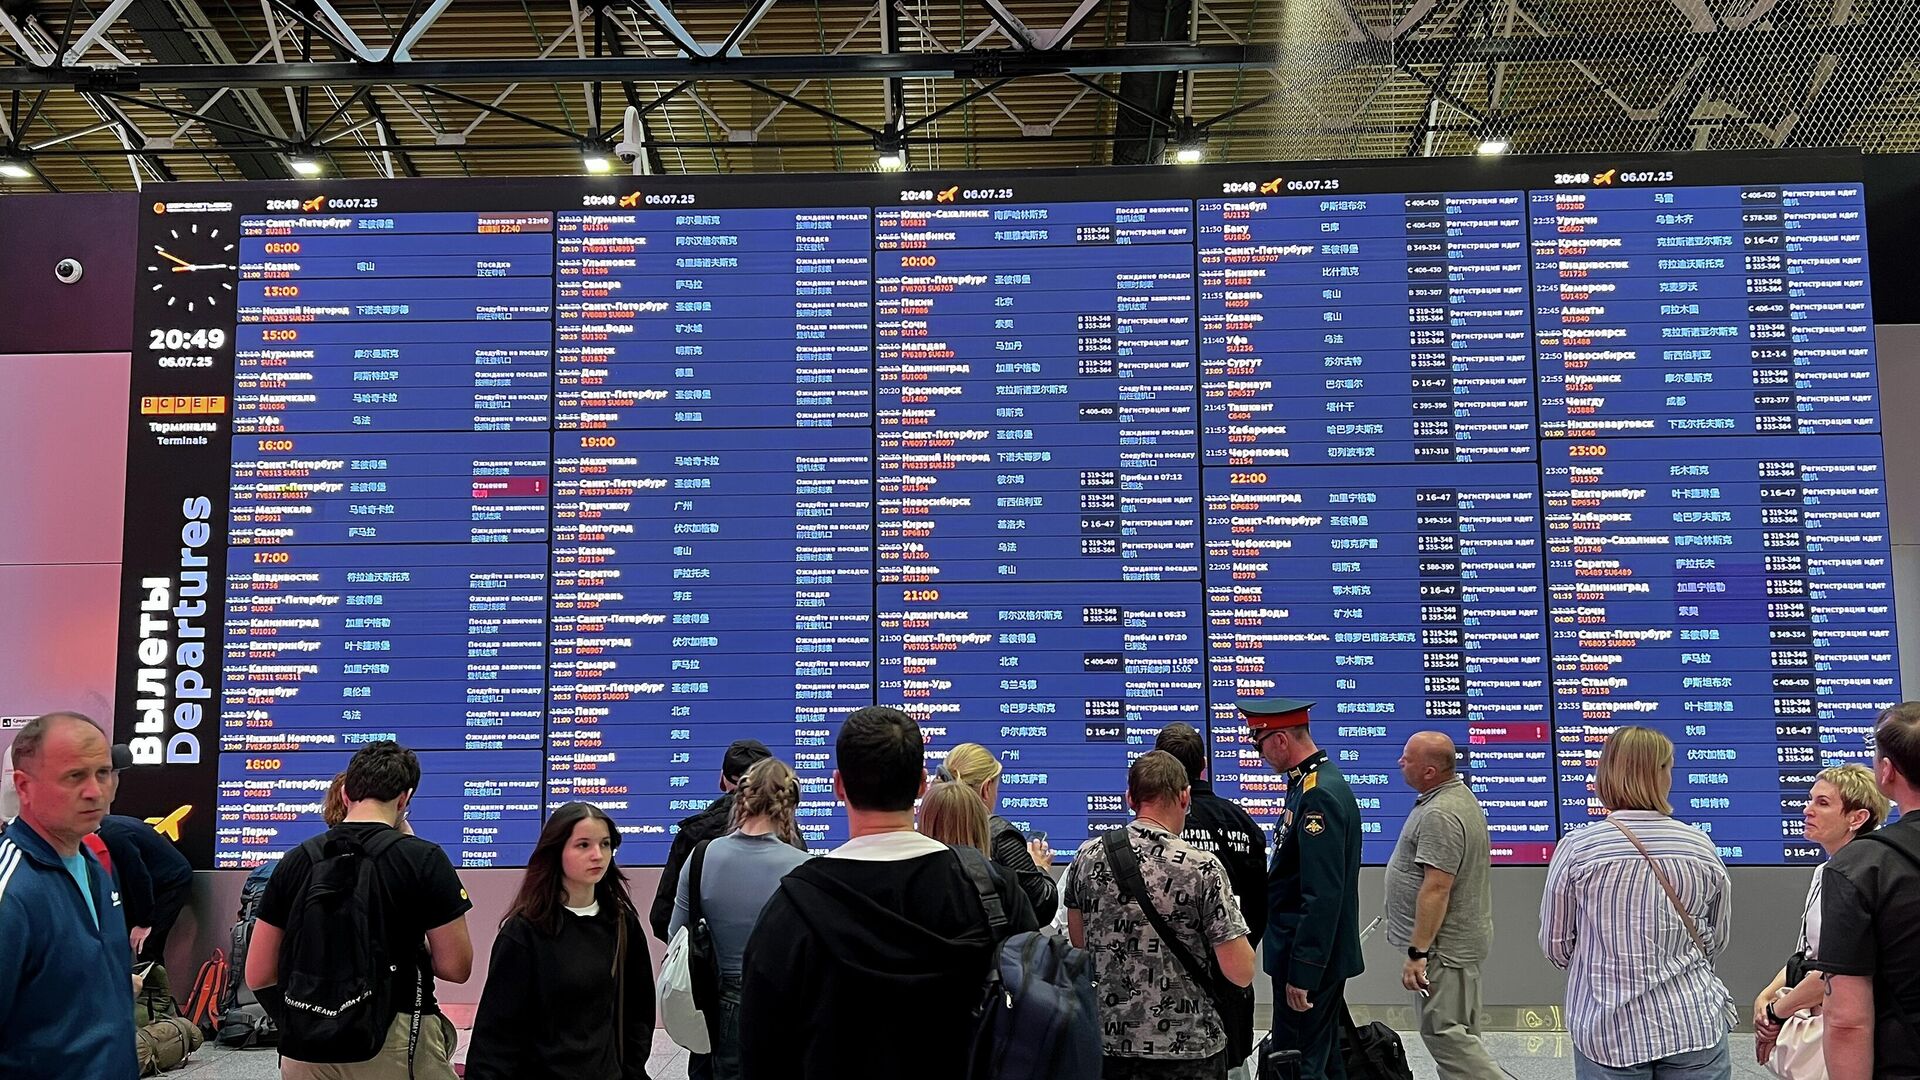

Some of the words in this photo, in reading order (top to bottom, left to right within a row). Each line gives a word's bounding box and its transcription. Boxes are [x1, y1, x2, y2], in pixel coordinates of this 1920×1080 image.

[1555, 173, 1589, 184] 20:49
[1620, 171, 1673, 182] 06.07.25
[1223, 182, 1256, 193] 20:49
[1287, 180, 1339, 191] 06.07.25
[583, 195, 615, 205] 20:49
[645, 194, 695, 204] 06.07.25
[901, 190, 933, 201] 20:49
[963, 189, 1013, 200] 06.07.25
[1532, 194, 1554, 202] 22:35
[1556, 193, 1586, 203] Мале
[266, 198, 299, 210] 20:49
[328, 198, 378, 209] 06.07.25
[1223, 201, 1267, 212] Стамбул
[900, 208, 990, 220] Южно-Сахалинск
[266, 217, 351, 229] Санкт-Петербург
[583, 215, 635, 225] Мурманск
[1557, 215, 1598, 226] Урумчи
[1200, 225, 1222, 233] 21:30
[1224, 224, 1249, 235] Баку
[583, 236, 646, 246] Архангельск
[900, 231, 956, 241] Челябинск
[265, 241, 300, 254] 08:00
[1558, 237, 1621, 248] Красноярск
[1224, 245, 1314, 257] Санкт-Петербург
[264, 261, 300, 272] Казань
[582, 258, 636, 268] Ульяновск
[901, 256, 936, 267] 20:00
[1535, 262, 1558, 270] 22:40
[1559, 259, 1629, 270] Владивосток
[263, 285, 298, 297] 13:00
[1560, 282, 1616, 293] Кемерово
[1201, 292, 1224, 300] 21:35
[262, 305, 301, 316] Нижний
[303, 306, 349, 317] Новгород
[1537, 307, 1560, 315] 22:45
[1561, 305, 1604, 315] Алматы
[902, 320, 927, 329] Сочи
[149, 328, 225, 349] 20:49
[262, 329, 297, 341] 15:00
[902, 341, 946, 352] Магадан
[261, 348, 314, 360] Мурманск
[1564, 349, 1636, 361] Новосибирск
[158, 356, 213, 367] 06.07.25
[1227, 358, 1263, 369] Сургут
[260, 370, 313, 382] Астрахань
[581, 368, 608, 378] Дели
[879, 387, 900, 395] 20:20
[902, 385, 962, 396] Красноярск
[144, 399, 152, 408] B
[161, 399, 169, 408] C
[177, 399, 185, 408] D
[194, 399, 201, 407] E
[210, 398, 217, 407] F
[1228, 402, 1273, 413] Ташкент
[1566, 396, 1605, 408] Ченгду
[1204, 404, 1226, 412] 21:45
[258, 415, 280, 427] Уфа
[581, 412, 618, 422] Ереван
[149, 422, 216, 433] Терминалы
[1567, 418, 1655, 429] Нижневартовск
[157, 436, 208, 445] Terminals
[258, 439, 292, 452] 16:00
[580, 436, 615, 448] 19:00
[1205, 448, 1227, 457] 21:55
[1229, 447, 1289, 459] Череповец
[1569, 445, 1606, 456] 23:00
[903, 453, 942, 463] Нижний
[944, 453, 990, 464] Новгород
[257, 458, 344, 471] Санкт-Петербург
[1545, 467, 1568, 475] 23:00
[1570, 466, 1603, 476] Томск
[902, 475, 937, 486] Пермь
[1231, 473, 1267, 484] 22:00
[1231, 493, 1302, 504] Калининград
[1571, 488, 1646, 500] Екатеринбург
[902, 496, 971, 507] Новосибирск
[255, 503, 312, 515] Махачкала
[1207, 517, 1230, 525] 22:00
[1231, 515, 1322, 527] Санкт-Петербург
[1572, 512, 1632, 522] Хабаровск
[578, 523, 633, 534] Волгоград
[902, 520, 935, 530] Киров
[1082, 520, 1088, 528] D
[1091, 520, 1114, 528] 16-47
[254, 526, 294, 538] Самара
[1231, 539, 1291, 550] Чебоксары
[1573, 534, 1669, 546] Южно-Сахалинск
[578, 546, 615, 556] Казань
[902, 542, 924, 554] Уфа
[254, 551, 288, 564] 17:00
[1208, 563, 1231, 571] 22:05
[1233, 562, 1268, 572] Минск
[1550, 560, 1573, 568] 23:15
[1574, 559, 1619, 569] Саратов
[578, 569, 620, 579] Саратов
[903, 565, 940, 575] Казань
[252, 571, 319, 583] Владивосток
[903, 590, 938, 601] 21:00
[1233, 585, 1262, 595] Омск
[1421, 586, 1428, 594] D
[1430, 586, 1455, 595] 16-47
[903, 610, 968, 620] Архангельск
[1234, 608, 1289, 619] Мин.Воды
[1577, 606, 1605, 617] Сочи
[251, 617, 319, 629] Калининград
[167, 496, 211, 764] Departures
[1578, 629, 1672, 641] Санкт-Петербург
[880, 634, 902, 643] 21:00
[250, 640, 321, 653] Екатеринбург
[880, 657, 902, 666] 21:05
[1580, 653, 1622, 665] Самара
[129, 577, 170, 765] Вылеты
[575, 682, 665, 694] Санкт-Петербург
[880, 681, 902, 689] 21:05
[903, 679, 952, 691] Улан-Удэ
[1212, 679, 1235, 687] 22:15
[1236, 678, 1275, 689] Казань
[1581, 677, 1627, 688] Стамбул
[248, 686, 298, 698] Оренбург
[575, 706, 609, 717] Пекин
[671, 706, 690, 716] 北京
[903, 702, 960, 714] Хабаровск
[1557, 702, 1580, 710] 23:35
[575, 716, 598, 724] CA910
[246, 732, 285, 744] Нижний
[288, 733, 335, 745] Новгород
[574, 730, 601, 740] Сочи
[574, 753, 615, 764] Шанхай
[671, 752, 690, 763] 上海
[1001, 750, 1020, 760] 广州
[245, 758, 281, 771] 18:00
[573, 777, 607, 787] Пенза
[1215, 774, 1238, 782] 22:30
[1240, 772, 1282, 783] Ижевск
[242, 826, 278, 838] Пермь
[1795, 848, 1820, 857] 16-47
[284, 996, 312, 1010] TOMMY
[312, 1005, 337, 1017] JEANS
[412, 1010, 421, 1035] TOMMY
